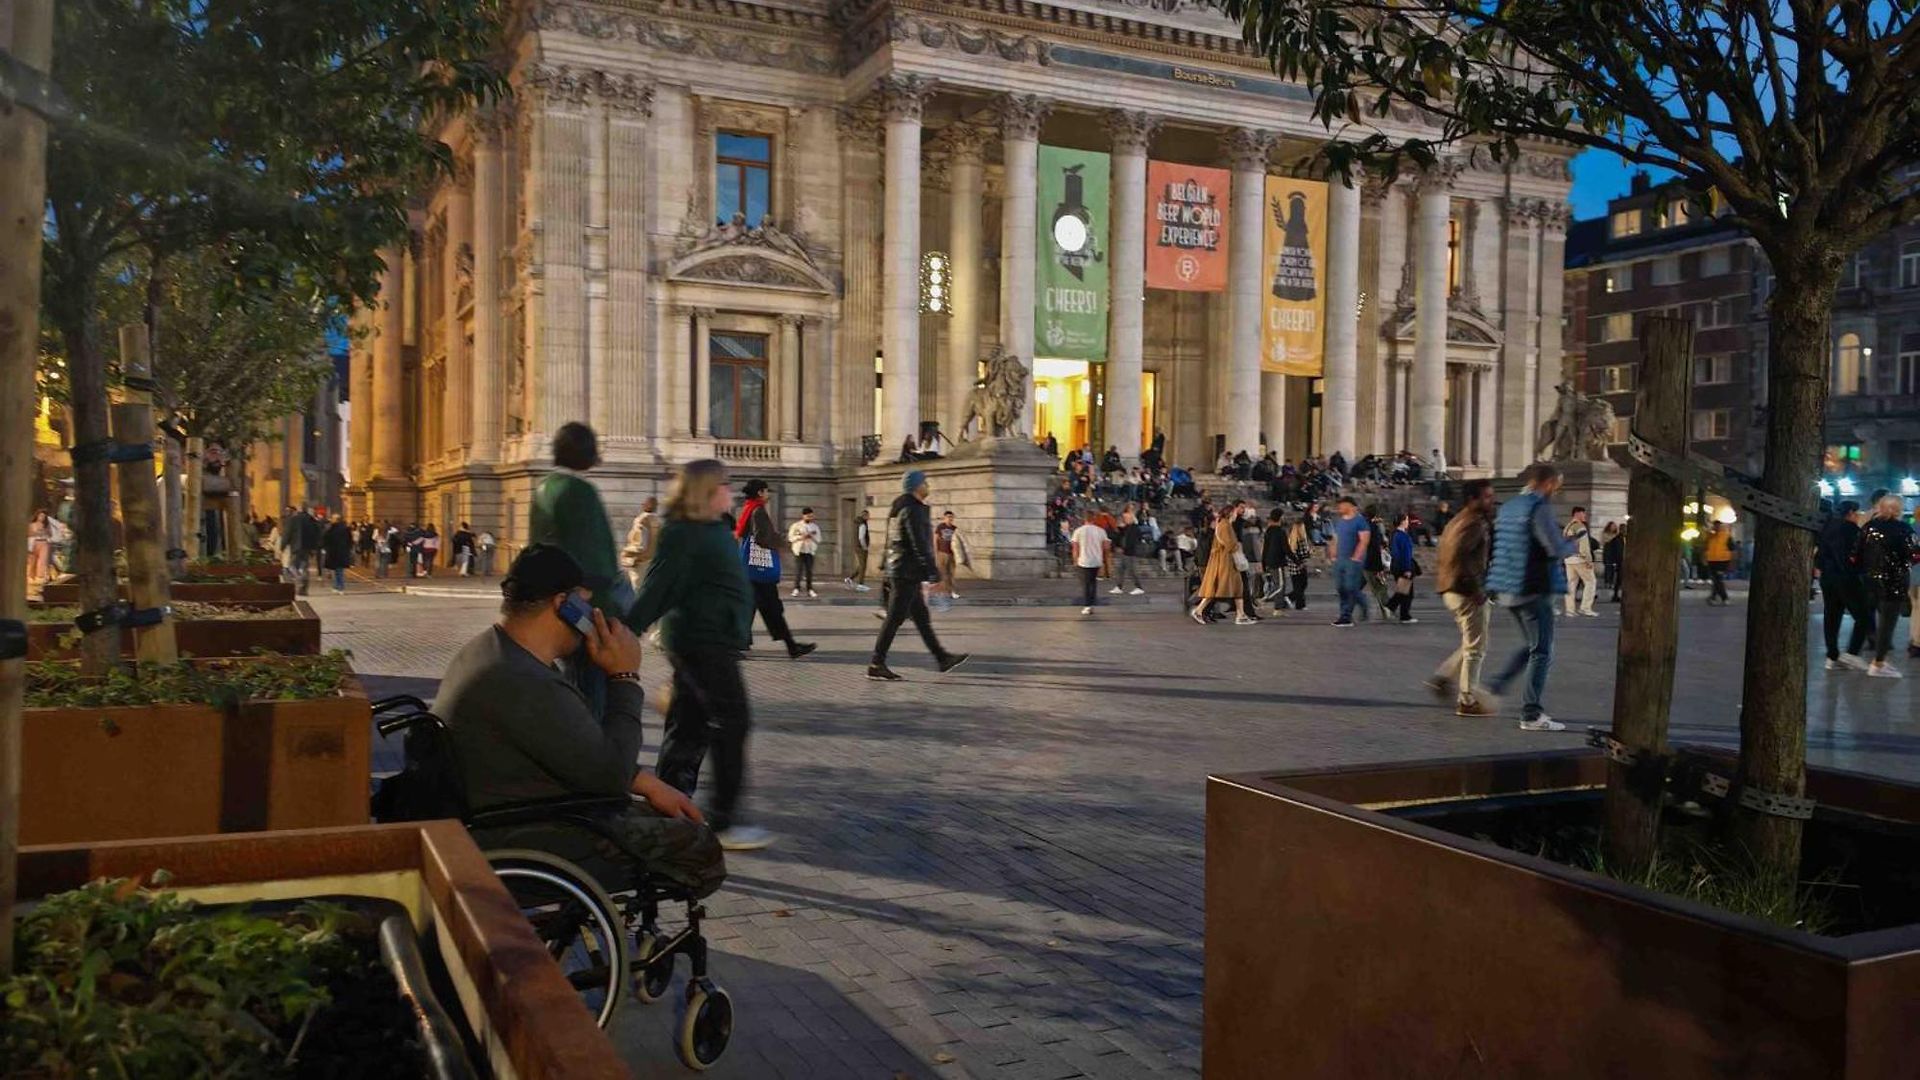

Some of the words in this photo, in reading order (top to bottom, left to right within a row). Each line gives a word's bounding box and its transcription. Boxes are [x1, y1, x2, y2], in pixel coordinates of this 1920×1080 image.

[1171, 182, 1208, 204] BELGIAN
[1157, 202, 1181, 223] BEER
[1182, 205, 1221, 227] WORLD
[1161, 224, 1216, 248] EXPERIENCE
[1046, 287, 1097, 315] CHEERS!
[1271, 307, 1315, 333] CHEERS!
